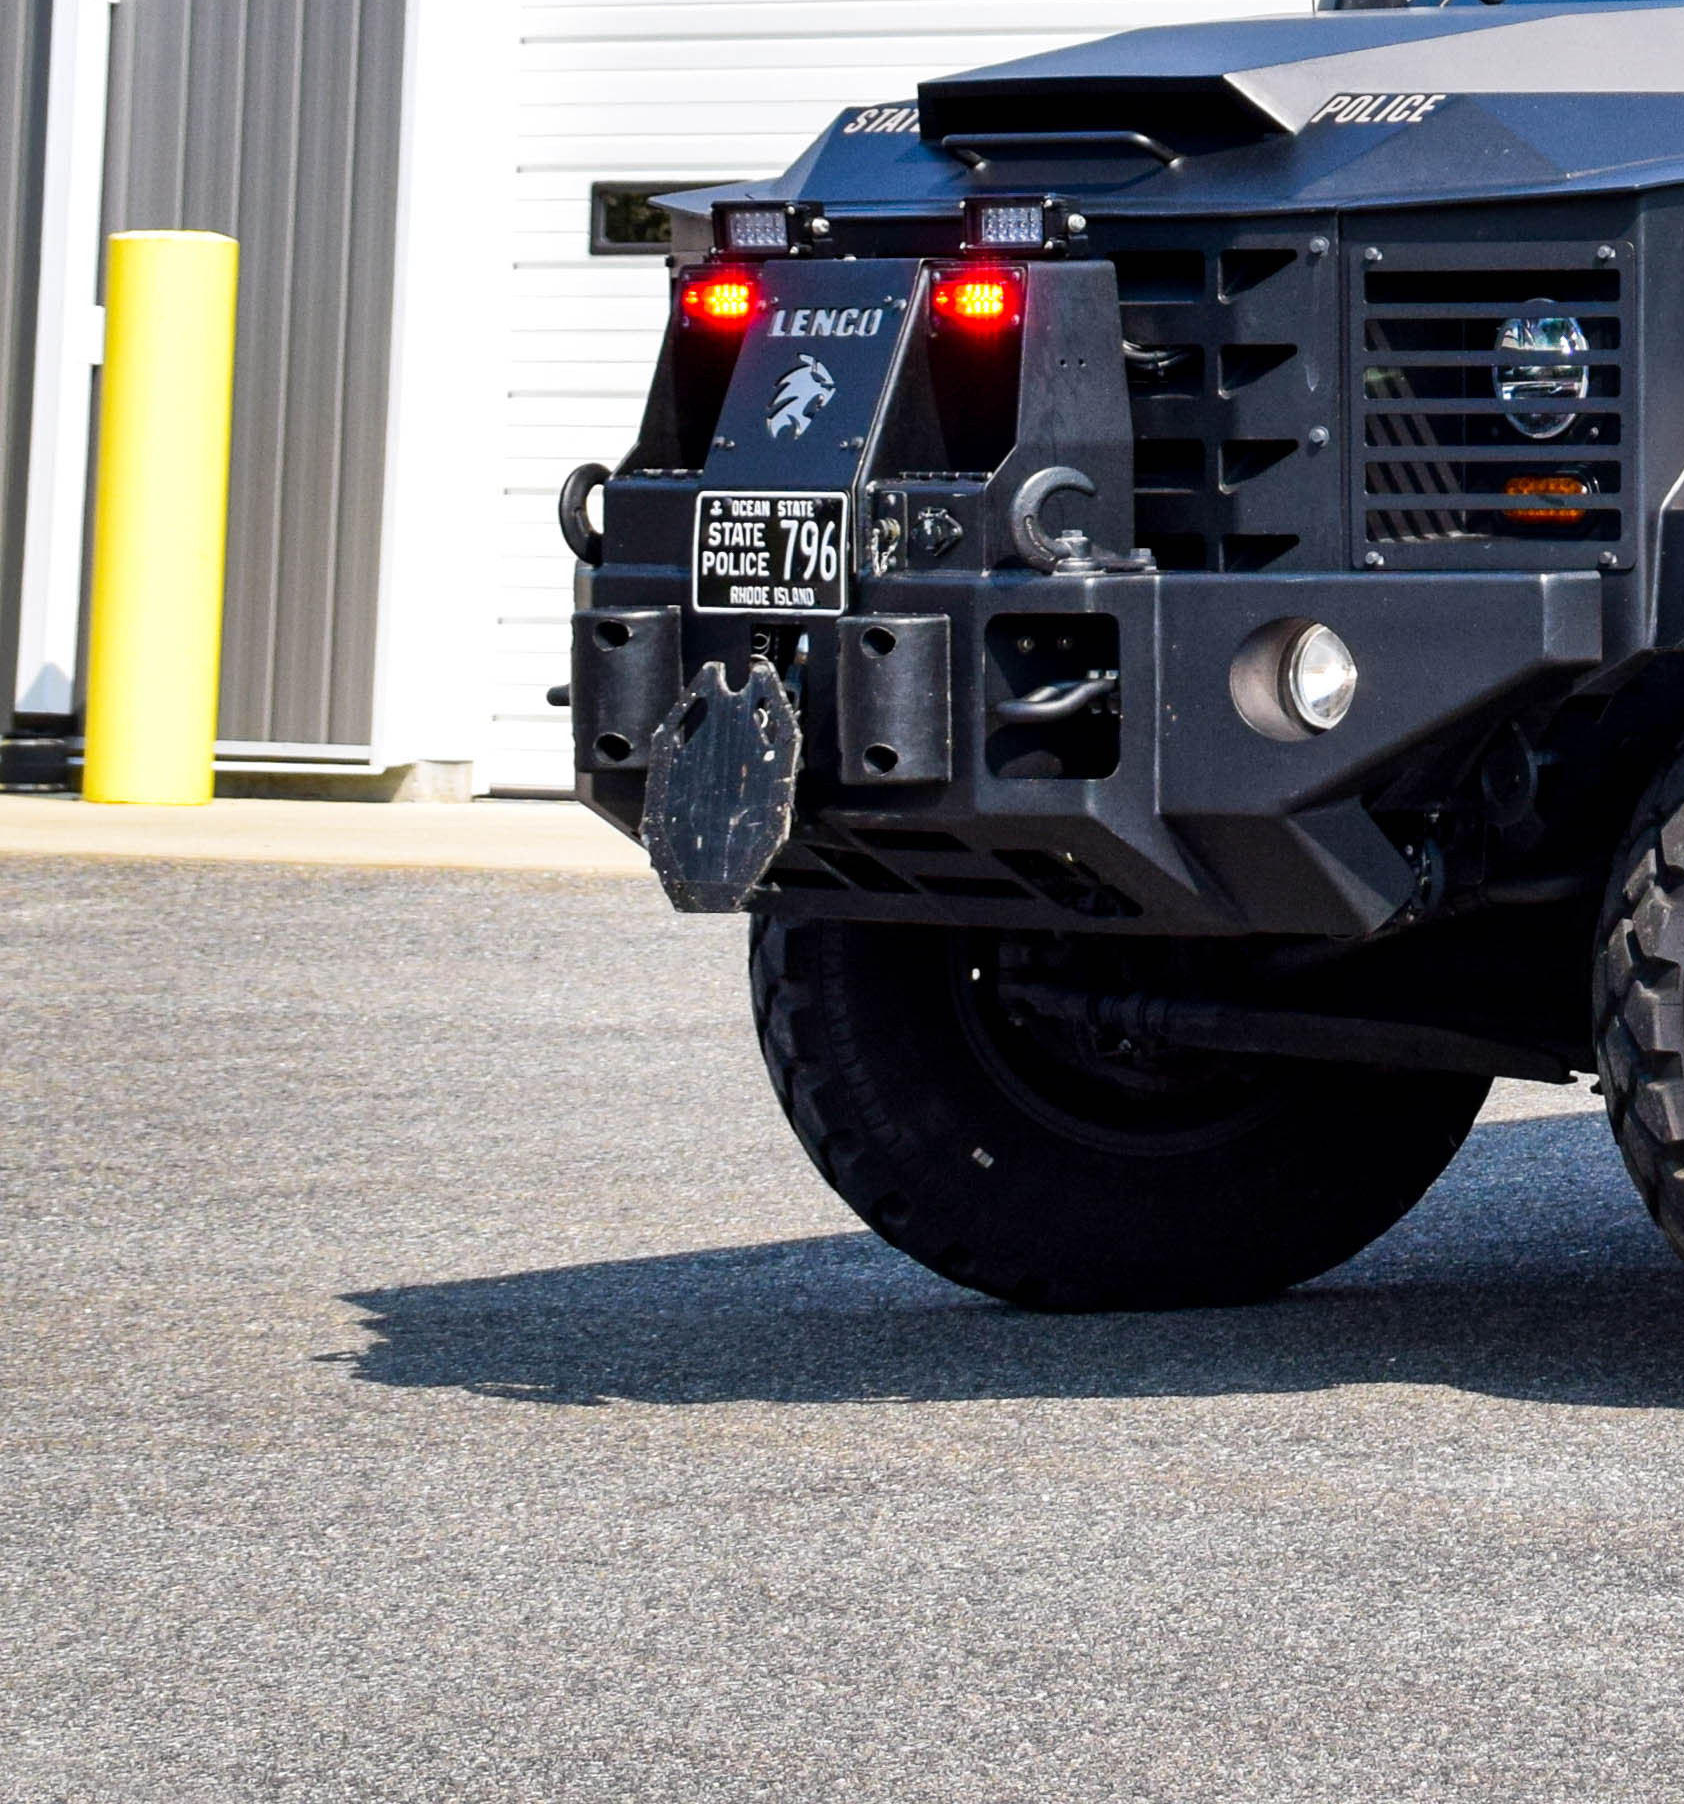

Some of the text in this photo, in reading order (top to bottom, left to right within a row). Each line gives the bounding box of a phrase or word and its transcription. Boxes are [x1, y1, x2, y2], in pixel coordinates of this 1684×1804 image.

[843, 94, 1447, 133] STAT POLICE
[768, 308, 883, 337] LENCO
[731, 499, 815, 517] OCEAN STATE
[702, 551, 770, 577] POLICE
[708, 519, 838, 582] STATE 796
[730, 585, 815, 607] RHODE ISLAND
